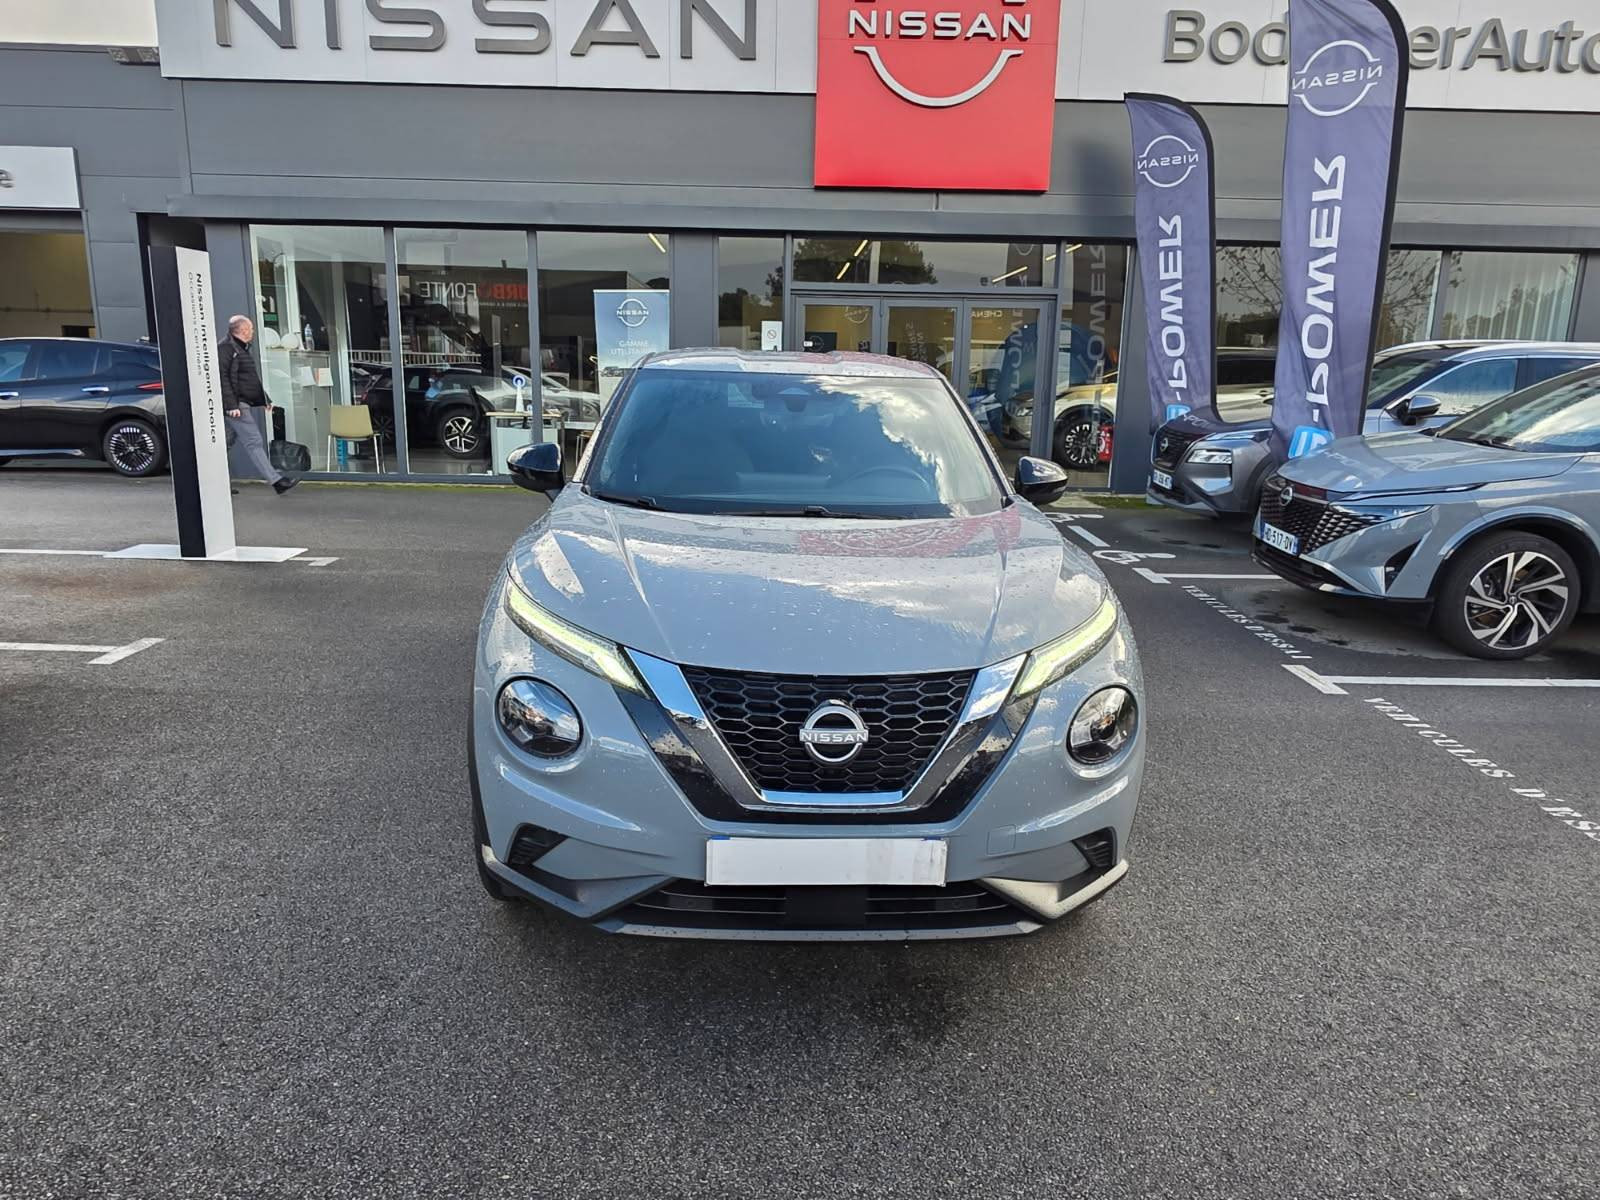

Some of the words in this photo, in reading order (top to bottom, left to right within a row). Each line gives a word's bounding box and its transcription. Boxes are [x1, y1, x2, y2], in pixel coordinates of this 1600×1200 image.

[215, 0, 757, 60] NISSAN
[849, 10, 1031, 40] NISSAN
[196, 273, 206, 321] Nissan
[201, 324, 213, 395] Intelligent
[208, 398, 216, 444] Choice
[800, 732, 868, 743] NISSAN
